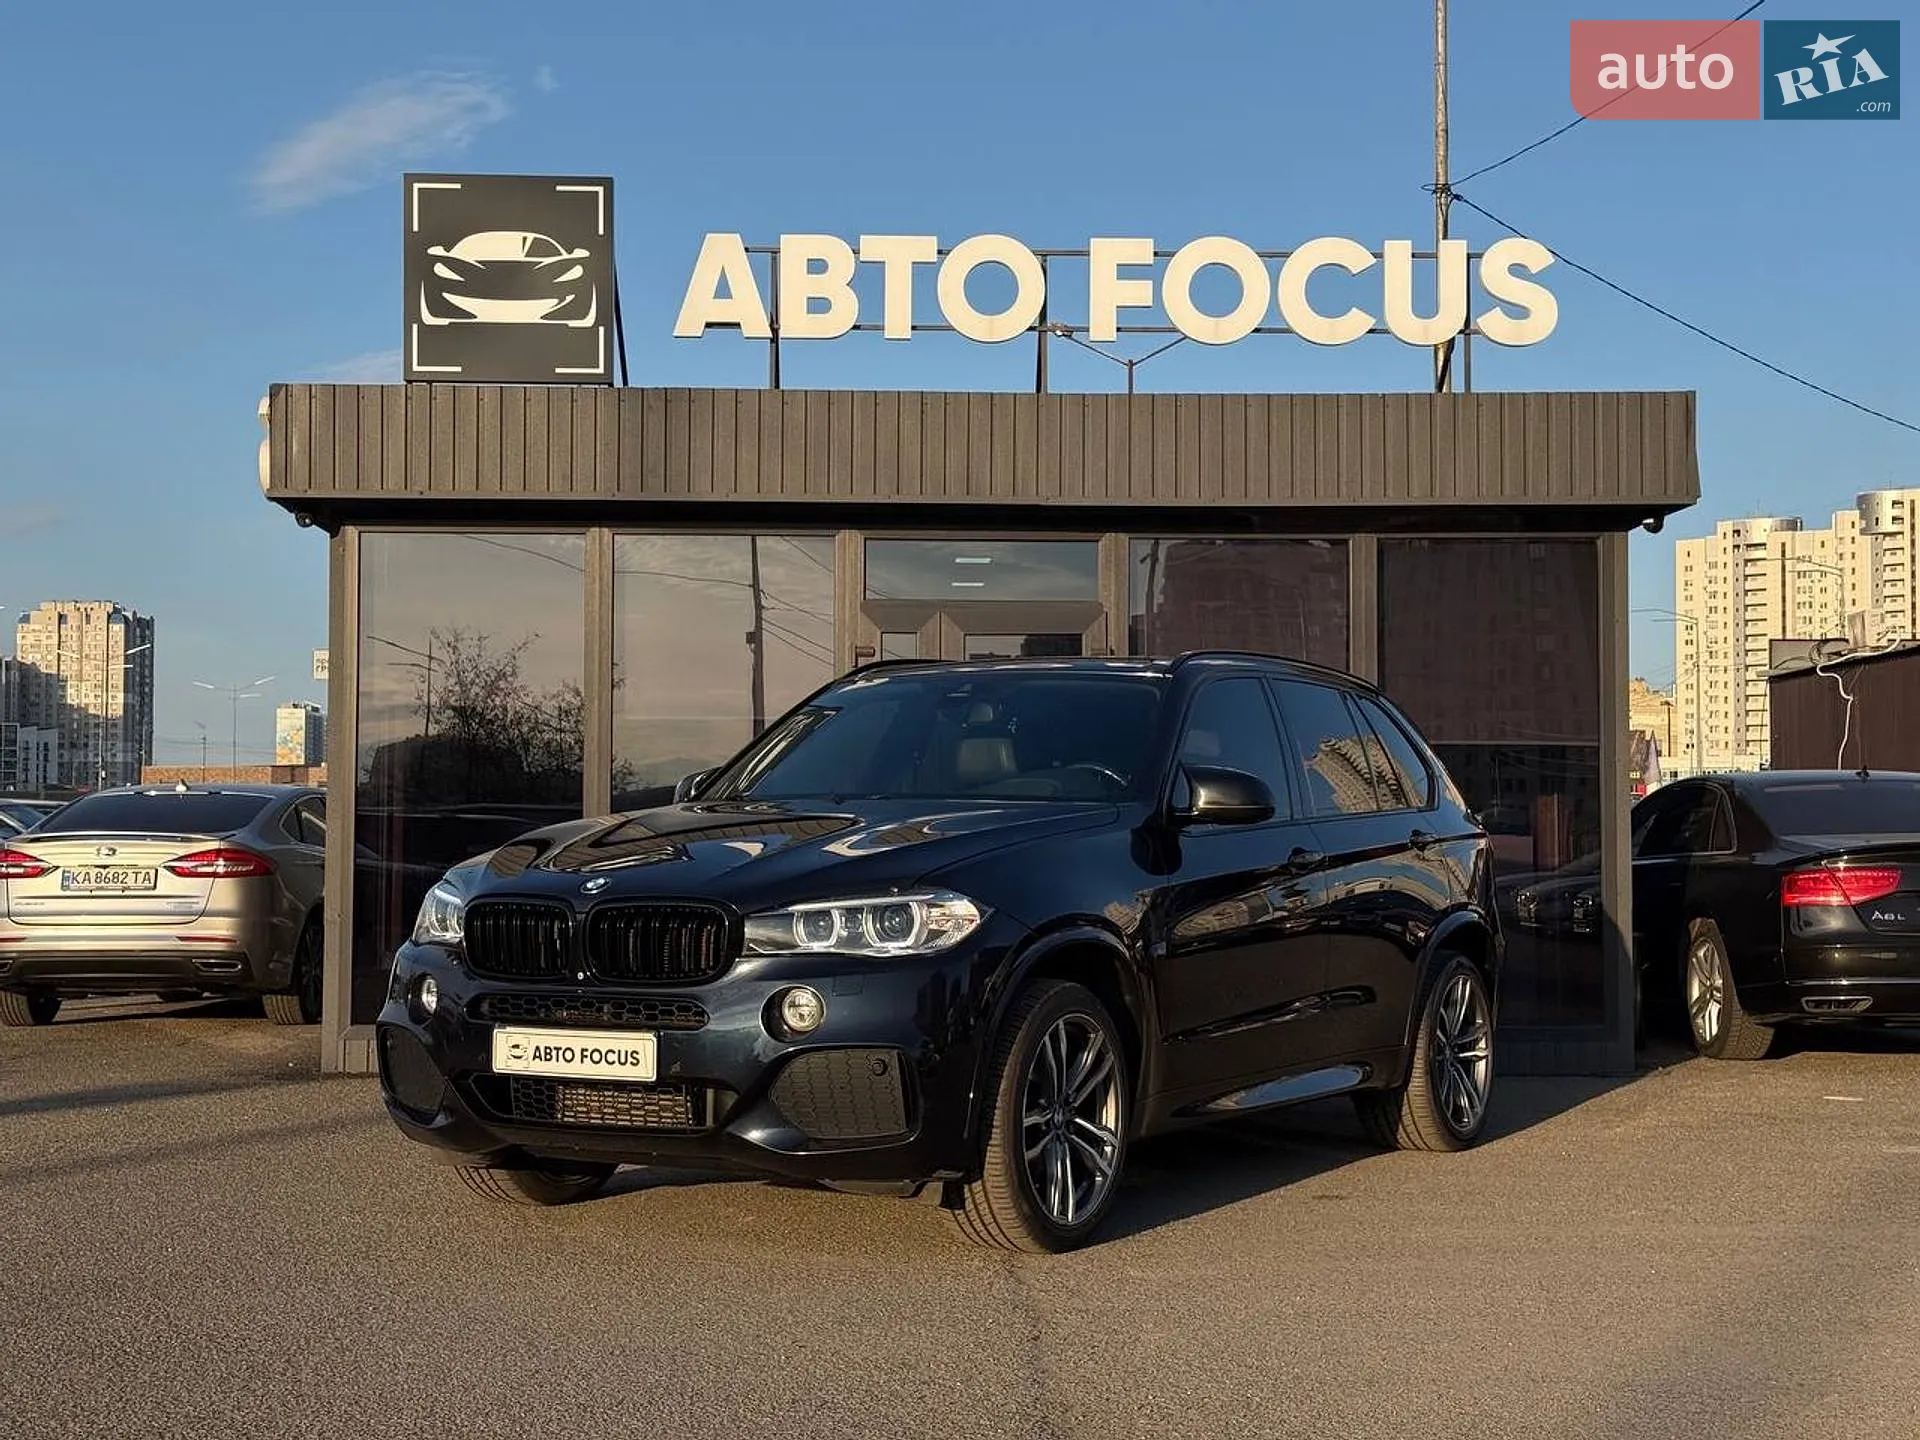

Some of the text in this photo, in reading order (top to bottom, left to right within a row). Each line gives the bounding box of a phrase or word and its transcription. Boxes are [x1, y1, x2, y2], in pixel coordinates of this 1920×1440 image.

[673, 232, 1559, 347] АВТО FOCUS
[71, 871, 152, 884] KA 8682 TA
[532, 1045, 640, 1067] АВТО FOCUS
